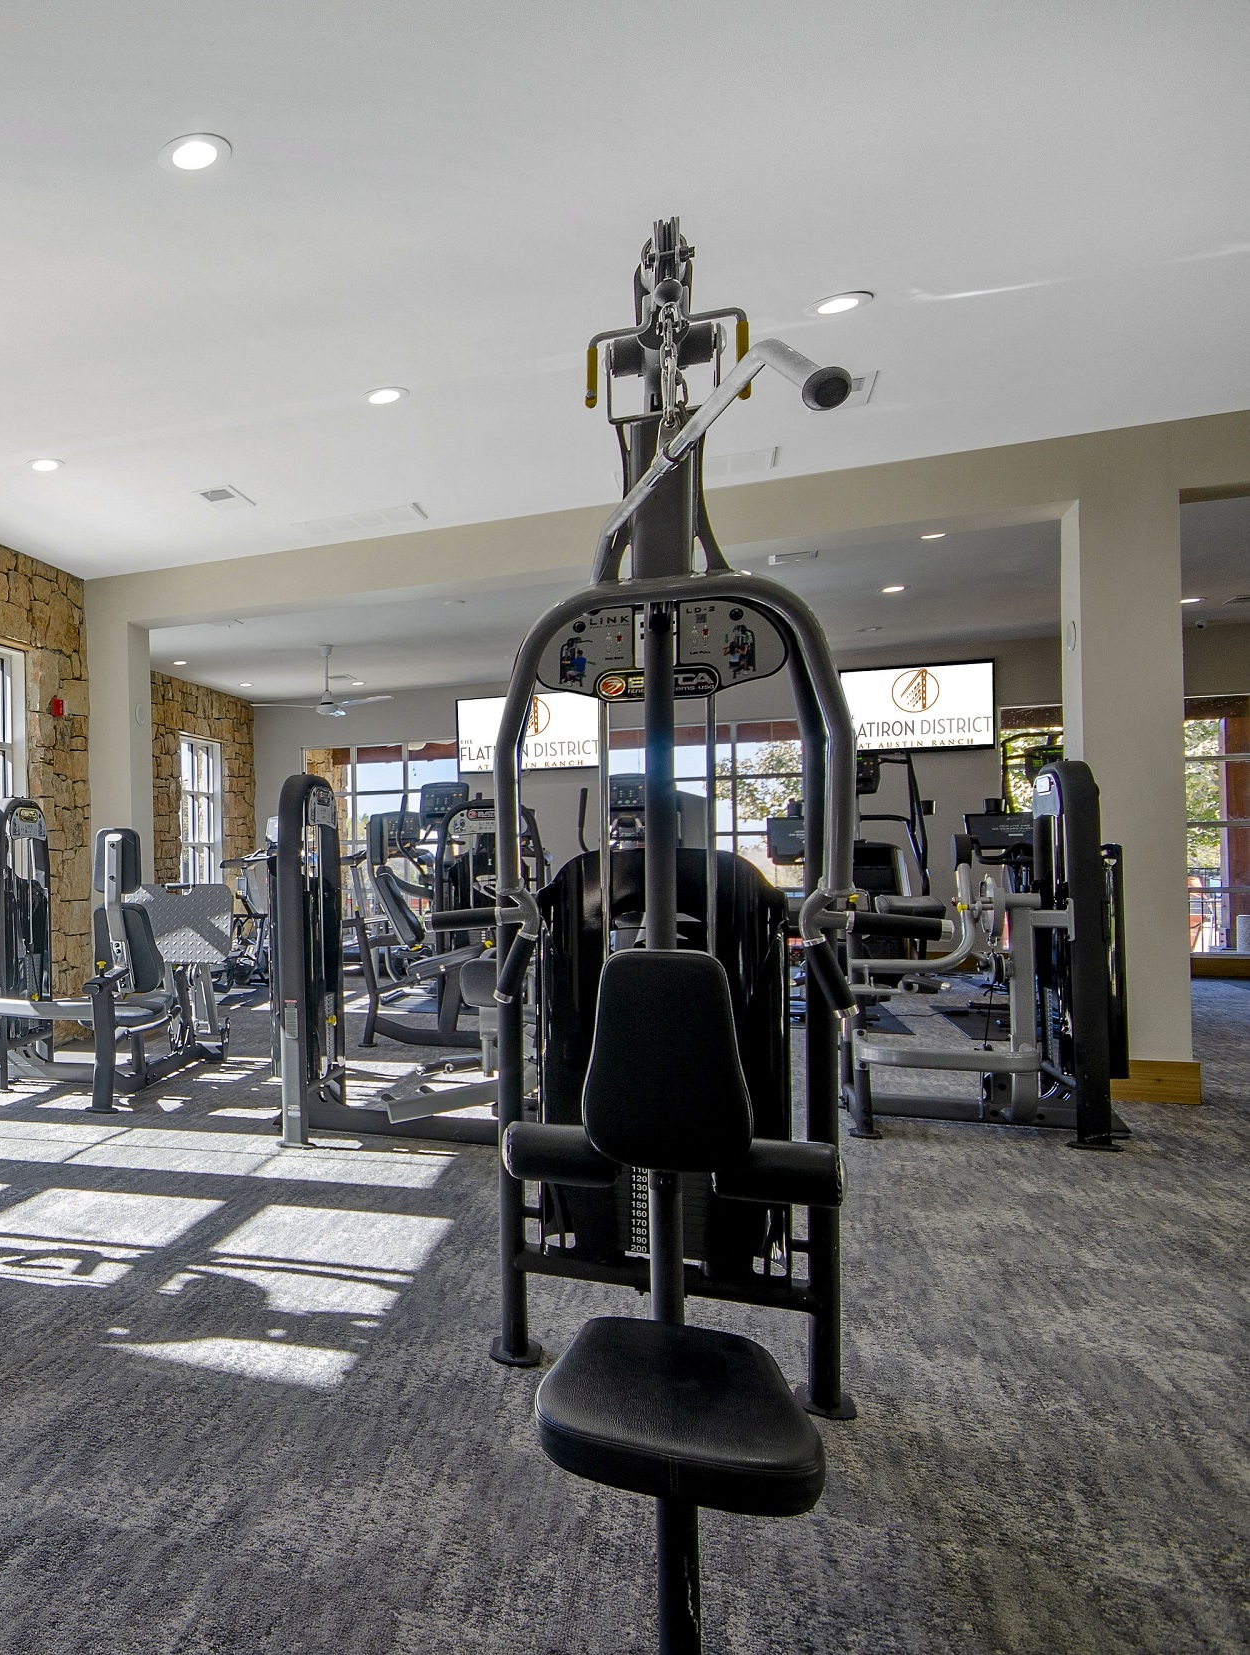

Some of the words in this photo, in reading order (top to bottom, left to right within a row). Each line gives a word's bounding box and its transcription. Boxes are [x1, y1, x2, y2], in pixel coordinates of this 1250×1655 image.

[590, 616, 630, 625] LINK
[857, 720, 915, 737] ATIRON
[921, 716, 992, 735] DISTRICT
[878, 739, 924, 748] AUSTIN
[931, 738, 974, 746] RANCH
[534, 740, 599, 757] DISTRICT
[631, 1175, 647, 1183] 120
[631, 1183, 647, 1191] 130
[631, 1192, 647, 1200] 140
[631, 1201, 647, 1209] 150
[631, 1210, 647, 1218] 160
[631, 1219, 647, 1227] 170
[631, 1236, 647, 1244] 190
[631, 1245, 647, 1253] 200
